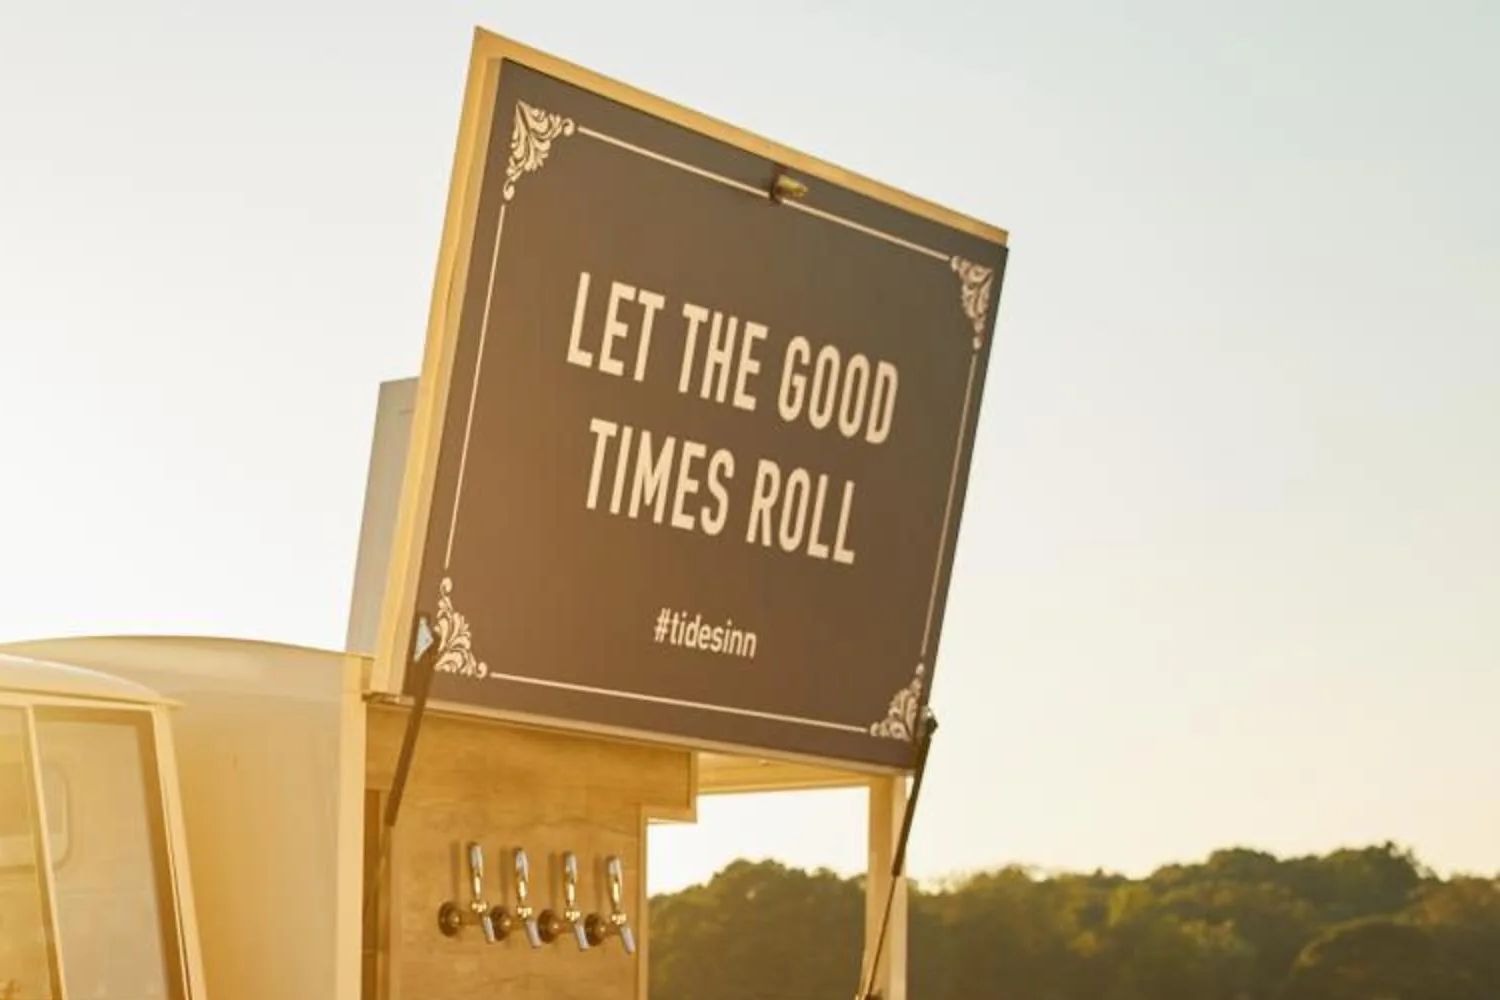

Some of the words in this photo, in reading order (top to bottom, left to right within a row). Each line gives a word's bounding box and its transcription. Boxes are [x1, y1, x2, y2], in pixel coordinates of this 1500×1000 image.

[566, 272, 666, 381] LET
[679, 303, 768, 410] THE
[779, 336, 898, 443] GOOD
[587, 417, 735, 535] TIMES
[747, 459, 855, 563] ROLL
[654, 607, 757, 658] #tidesinn
